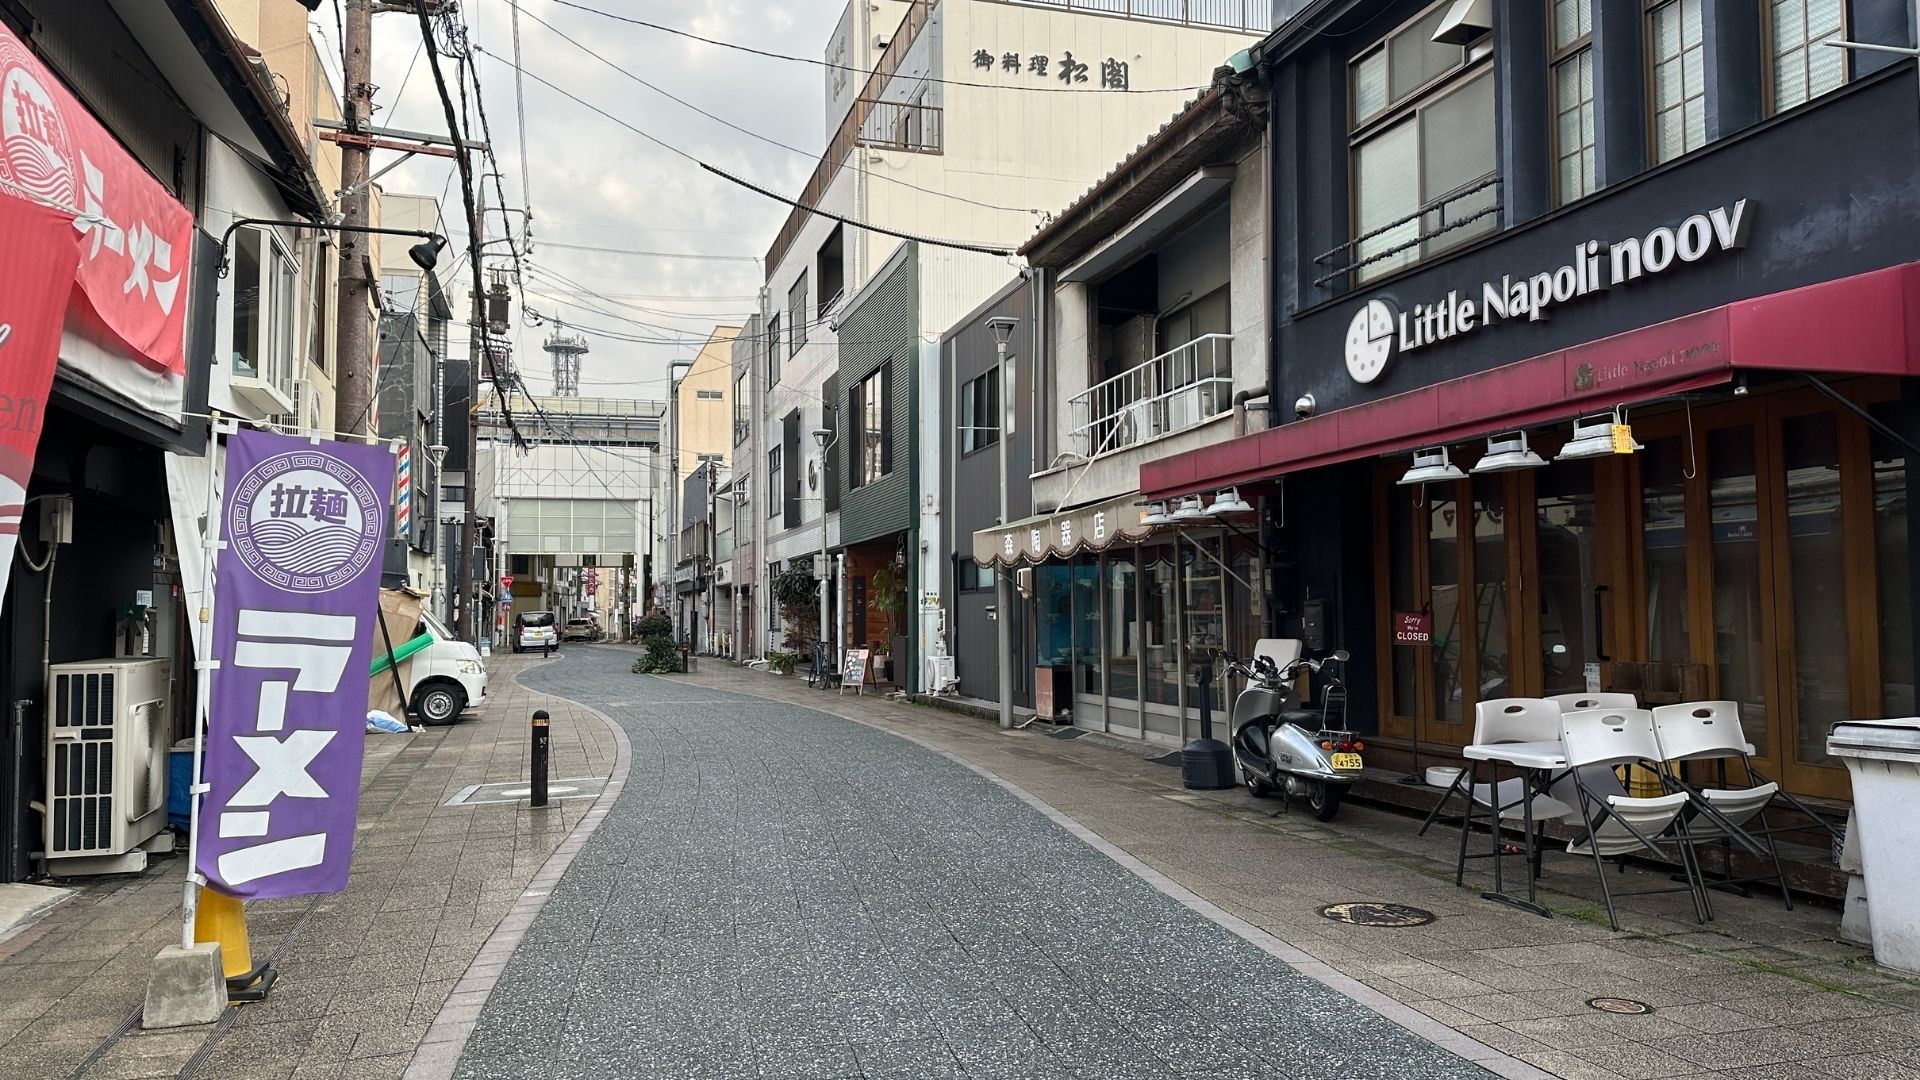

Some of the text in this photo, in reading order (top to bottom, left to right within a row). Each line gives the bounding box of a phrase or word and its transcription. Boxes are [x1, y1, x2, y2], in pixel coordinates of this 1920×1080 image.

[1400, 198, 1748, 353] Little Napoli noov
[270, 482, 349, 525] 拉麺
[1404, 615, 1421, 626] Sorry
[1397, 631, 1429, 641] CLOSED
[218, 609, 356, 886] ラーメン
[1340, 759, 1361, 768] 4755
